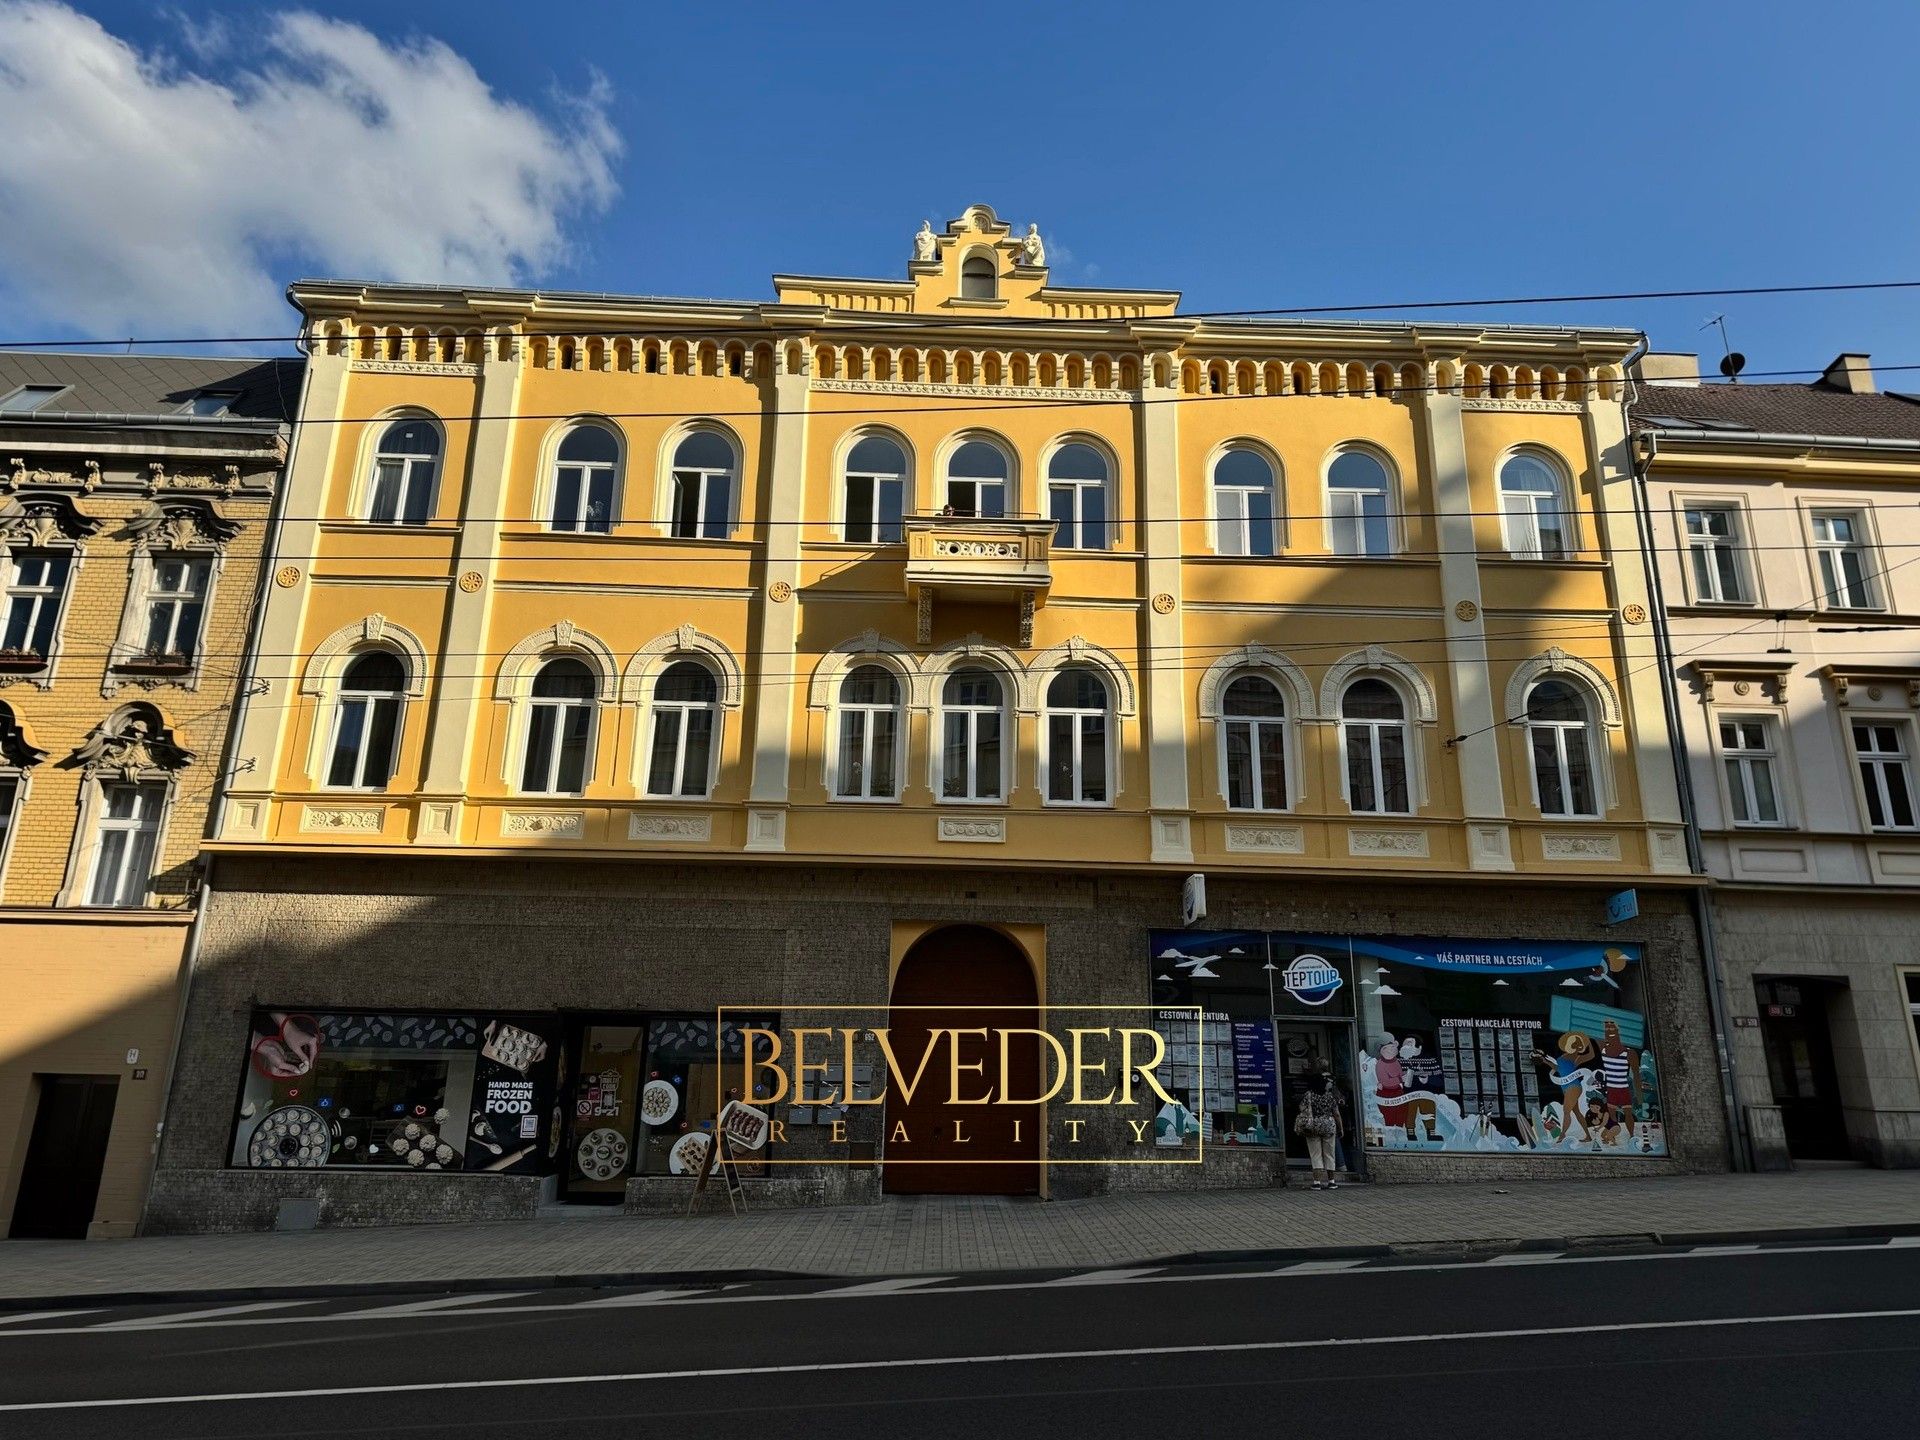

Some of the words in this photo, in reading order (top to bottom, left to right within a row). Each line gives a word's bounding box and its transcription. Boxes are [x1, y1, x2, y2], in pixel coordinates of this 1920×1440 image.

[1436, 951, 1453, 964] VÁŠ
[1454, 954, 1492, 965] PARTNER
[1493, 955, 1506, 965] NA
[1506, 954, 1543, 966] CESTÁCH
[1285, 969, 1338, 987] TEPTOUR
[1159, 1010, 1192, 1020] CESTOVNÍ
[1193, 1011, 1230, 1021] AENTURA
[1441, 1017, 1474, 1027] CESTOVNÍ
[1475, 1018, 1511, 1028] KANCELÁŘ
[1512, 1020, 1542, 1029] TEPTOUR
[488, 1081, 510, 1089] HAND
[511, 1081, 534, 1089] MADE
[486, 1089, 533, 1100] FROZEN
[485, 1099, 532, 1114] FOOD
